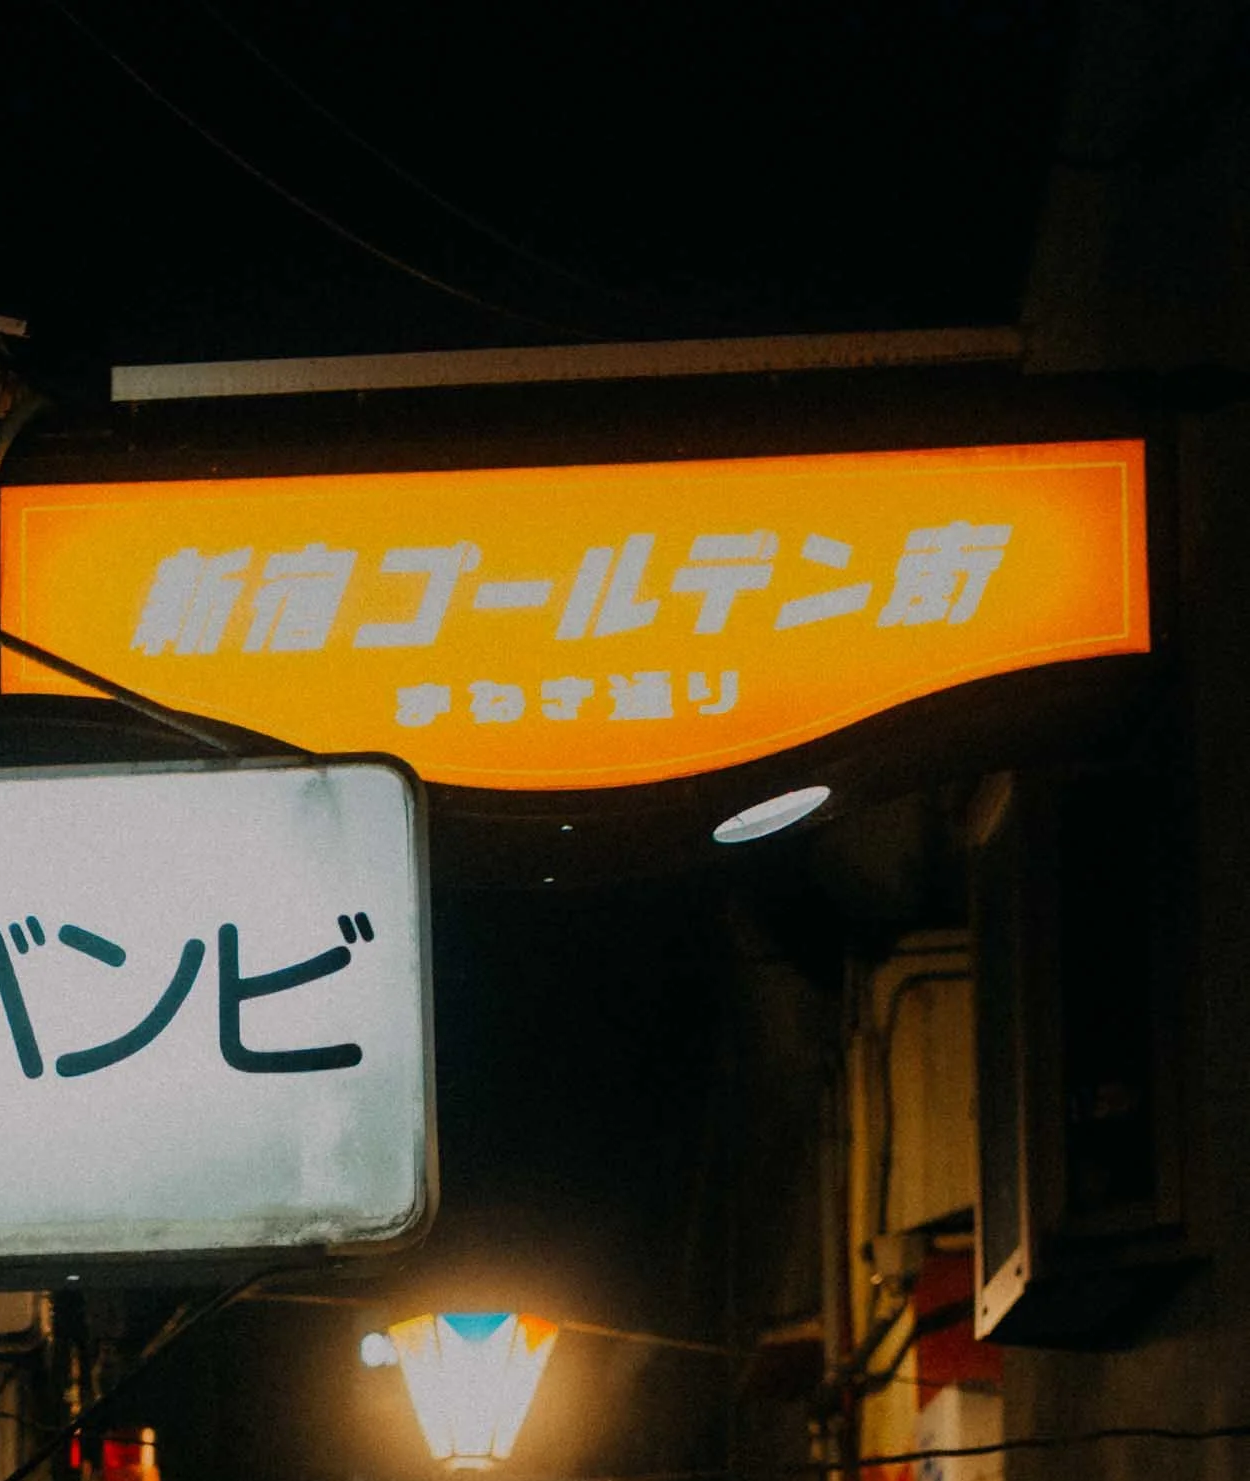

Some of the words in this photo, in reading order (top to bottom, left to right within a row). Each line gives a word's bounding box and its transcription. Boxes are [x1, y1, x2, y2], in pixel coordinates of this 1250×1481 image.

[130, 520, 1013, 656] 新宿ゴールデン街
[394, 670, 740, 728] まねき通り
